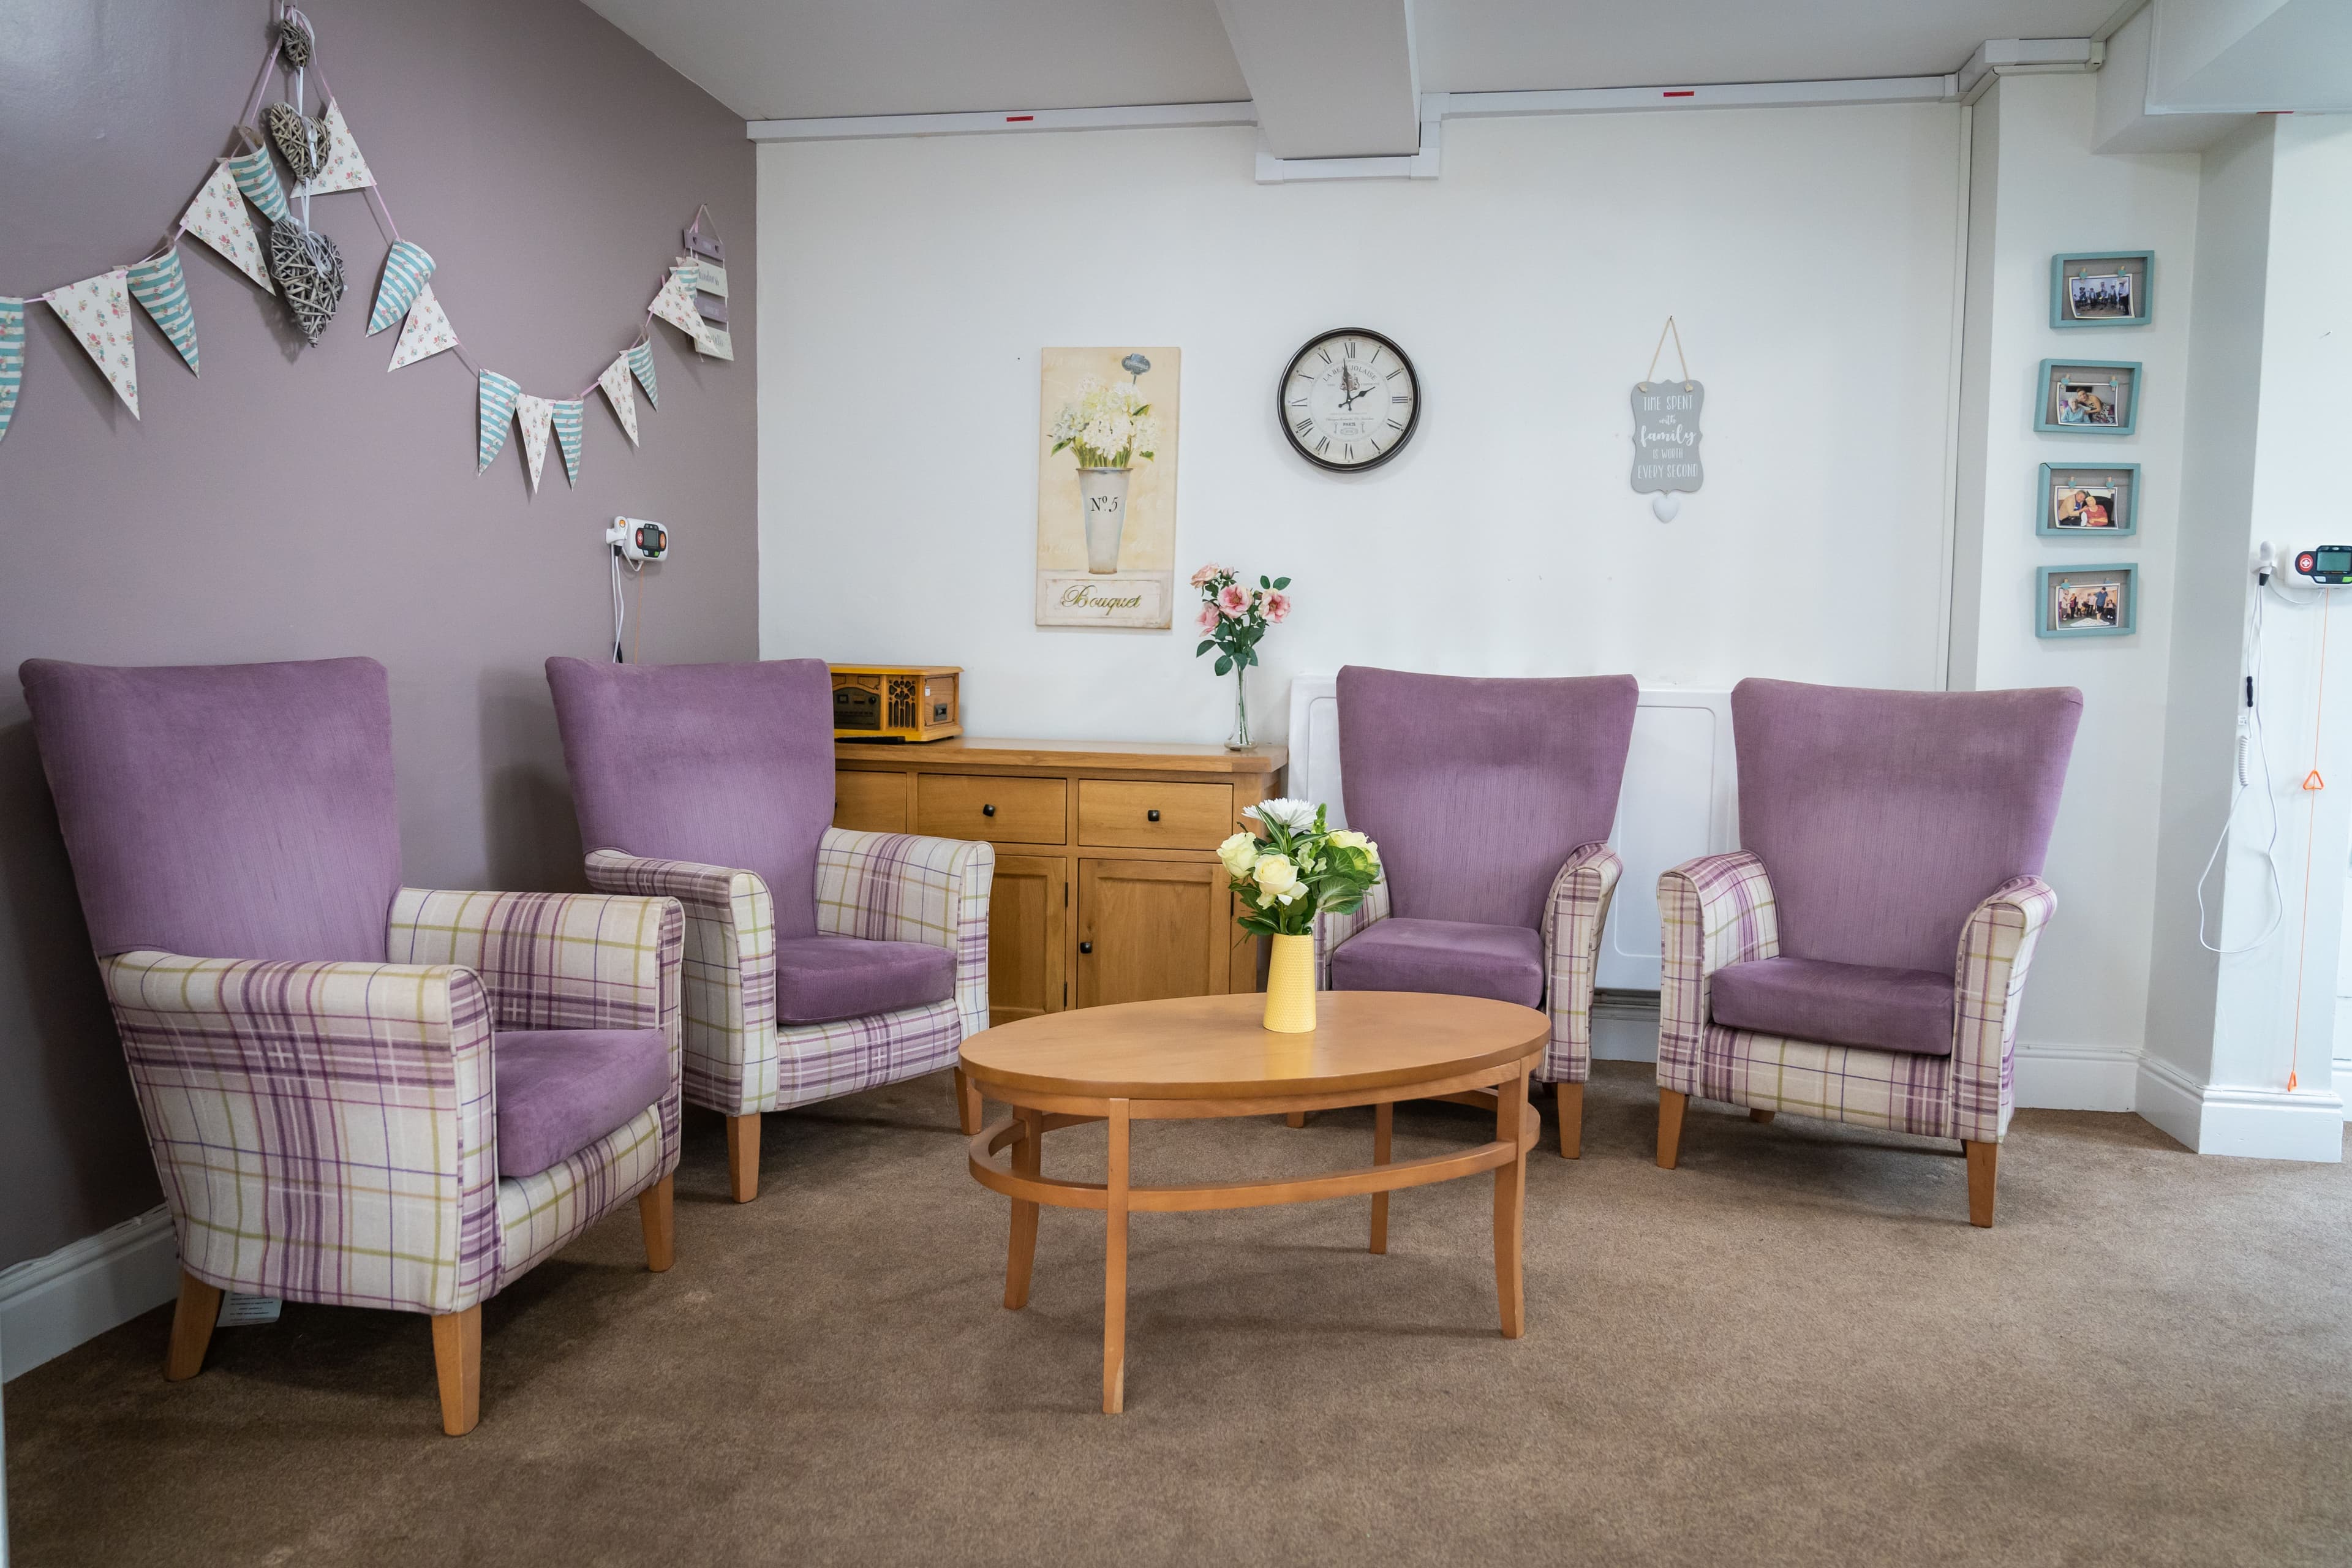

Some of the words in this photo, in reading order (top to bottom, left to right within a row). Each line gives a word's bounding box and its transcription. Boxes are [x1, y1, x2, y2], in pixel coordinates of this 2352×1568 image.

[1643, 396, 1661, 411] TIME
[1667, 395, 1693, 410] SPENT
[1659, 414, 1676, 425] with
[1641, 424, 1696, 447] family
[1653, 448, 1659, 459] IS
[1661, 448, 1683, 459] WORTH
[1638, 465, 1664, 478] EVERY
[1667, 464, 1698, 478] SECOND
[1061, 584, 1142, 616] Bouquet
